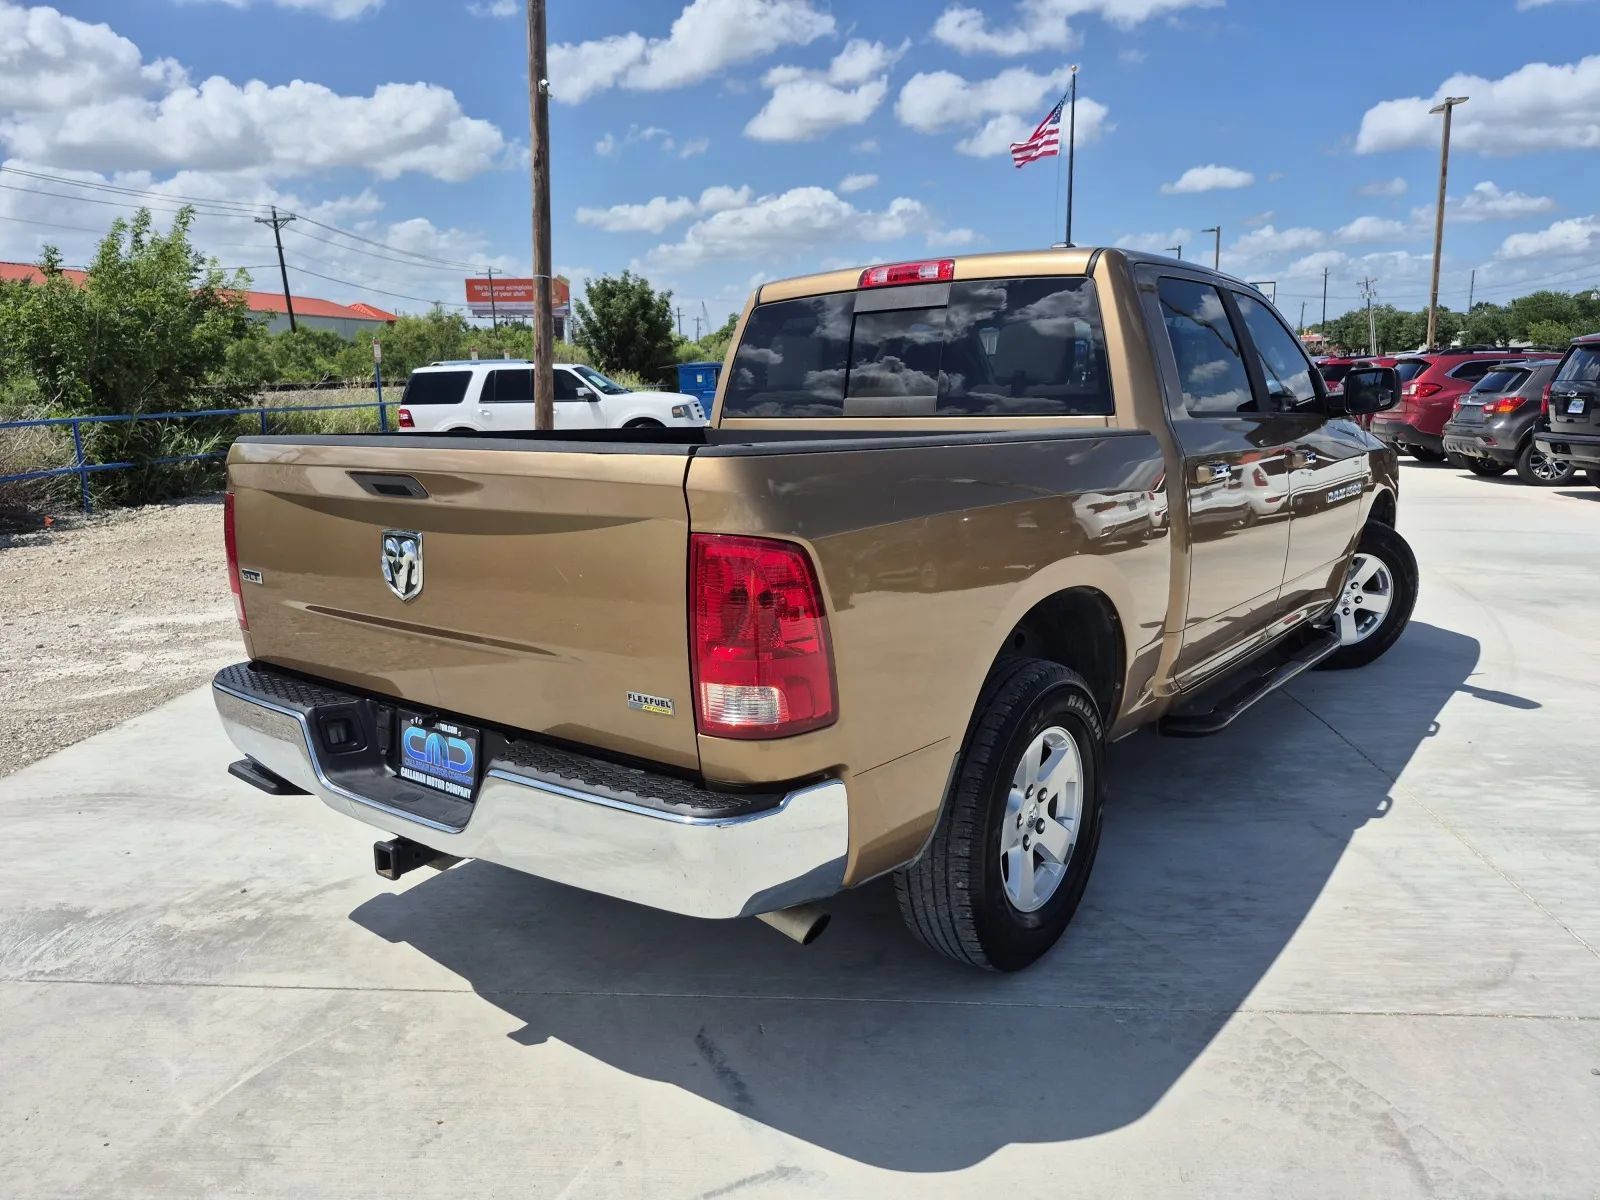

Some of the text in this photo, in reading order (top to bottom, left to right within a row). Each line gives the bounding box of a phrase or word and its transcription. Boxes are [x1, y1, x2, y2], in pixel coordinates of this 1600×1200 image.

[242, 570, 260, 582] SLT
[627, 693, 671, 708] FLEXFUEL
[1067, 694, 1102, 741] RADAR
[400, 766, 472, 799] CALLAHAN MOTOR COMPANY
